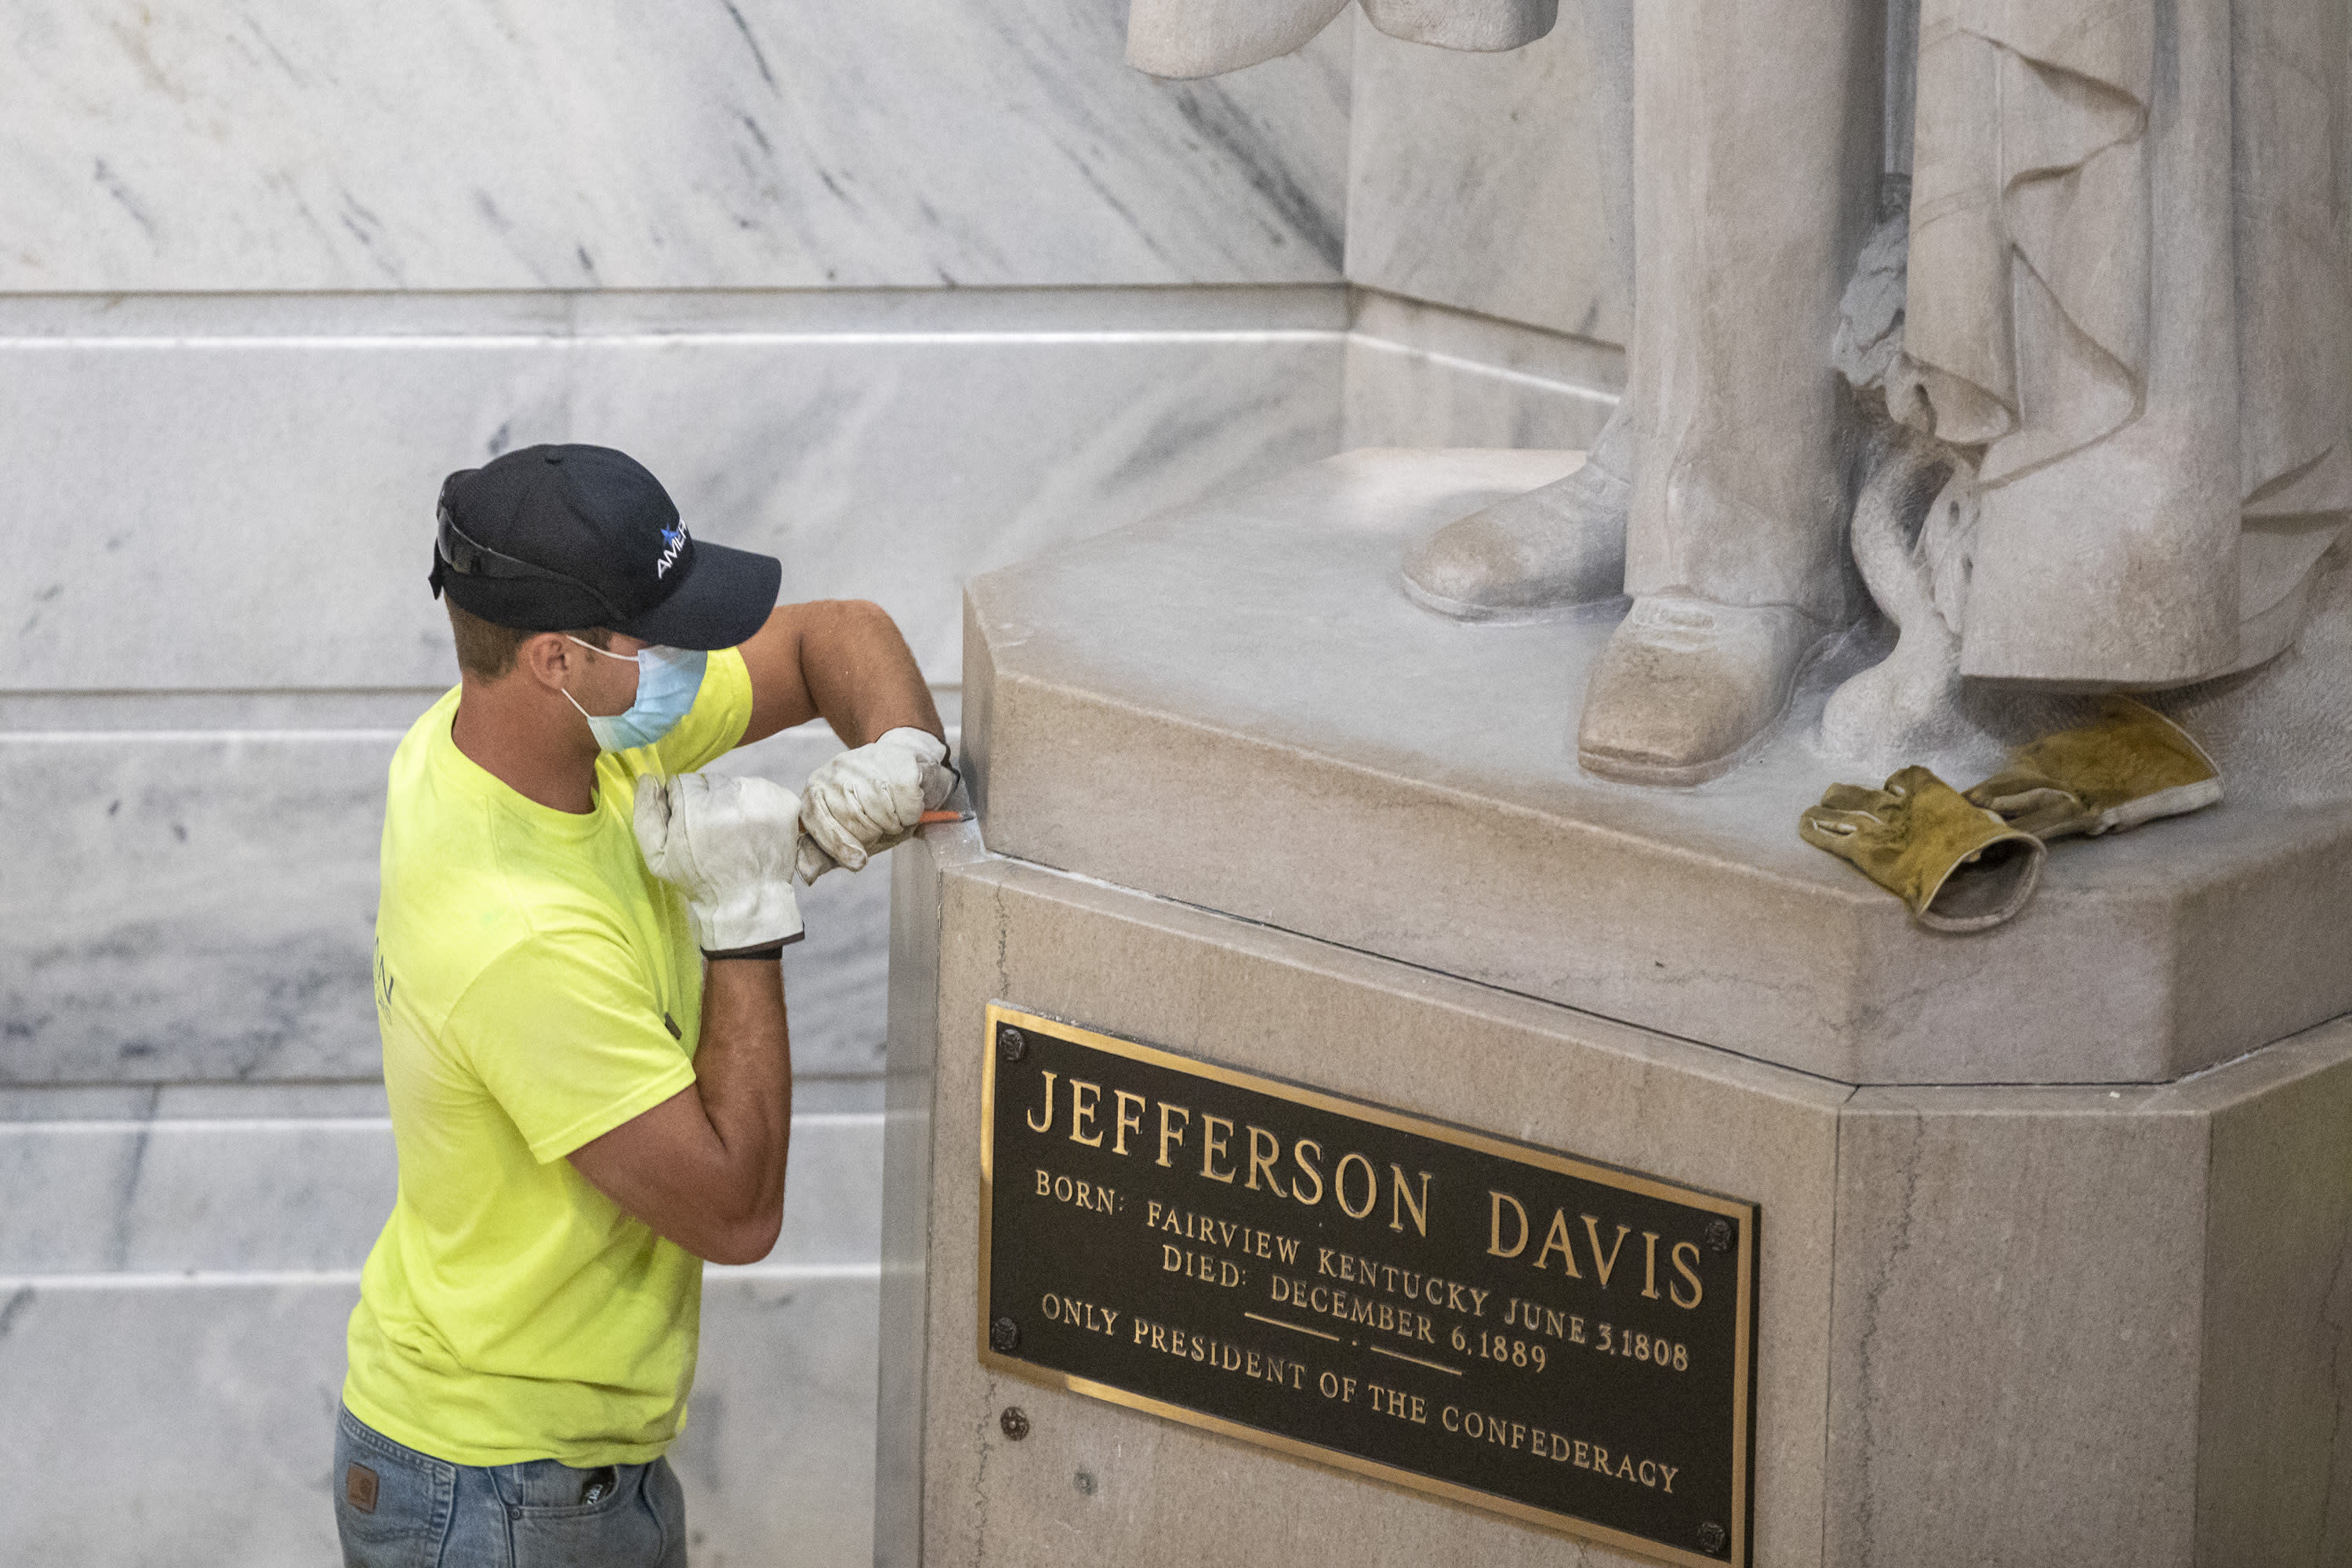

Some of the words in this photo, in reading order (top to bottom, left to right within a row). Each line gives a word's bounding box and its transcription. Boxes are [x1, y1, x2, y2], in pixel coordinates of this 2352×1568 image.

[1027, 1070, 1432, 1237] JEFFERSON
[1487, 1190, 1704, 1310] DAVIS
[1035, 1169, 1127, 1216] BORN:
[1146, 1200, 1301, 1265] FAIRVIEW
[1318, 1248, 1488, 1316] KENTUCKY
[1504, 1298, 1586, 1345] JUNE
[1162, 1244, 1247, 1288] DIED:
[1271, 1275, 1435, 1344] DECEMBER
[1042, 1293, 1120, 1337] ONLY
[1134, 1319, 1306, 1390] PRESIDENT
[1319, 1372, 1357, 1403] OF
[1369, 1385, 1428, 1424] THE
[1442, 1406, 1679, 1494] CONFEDERACY
